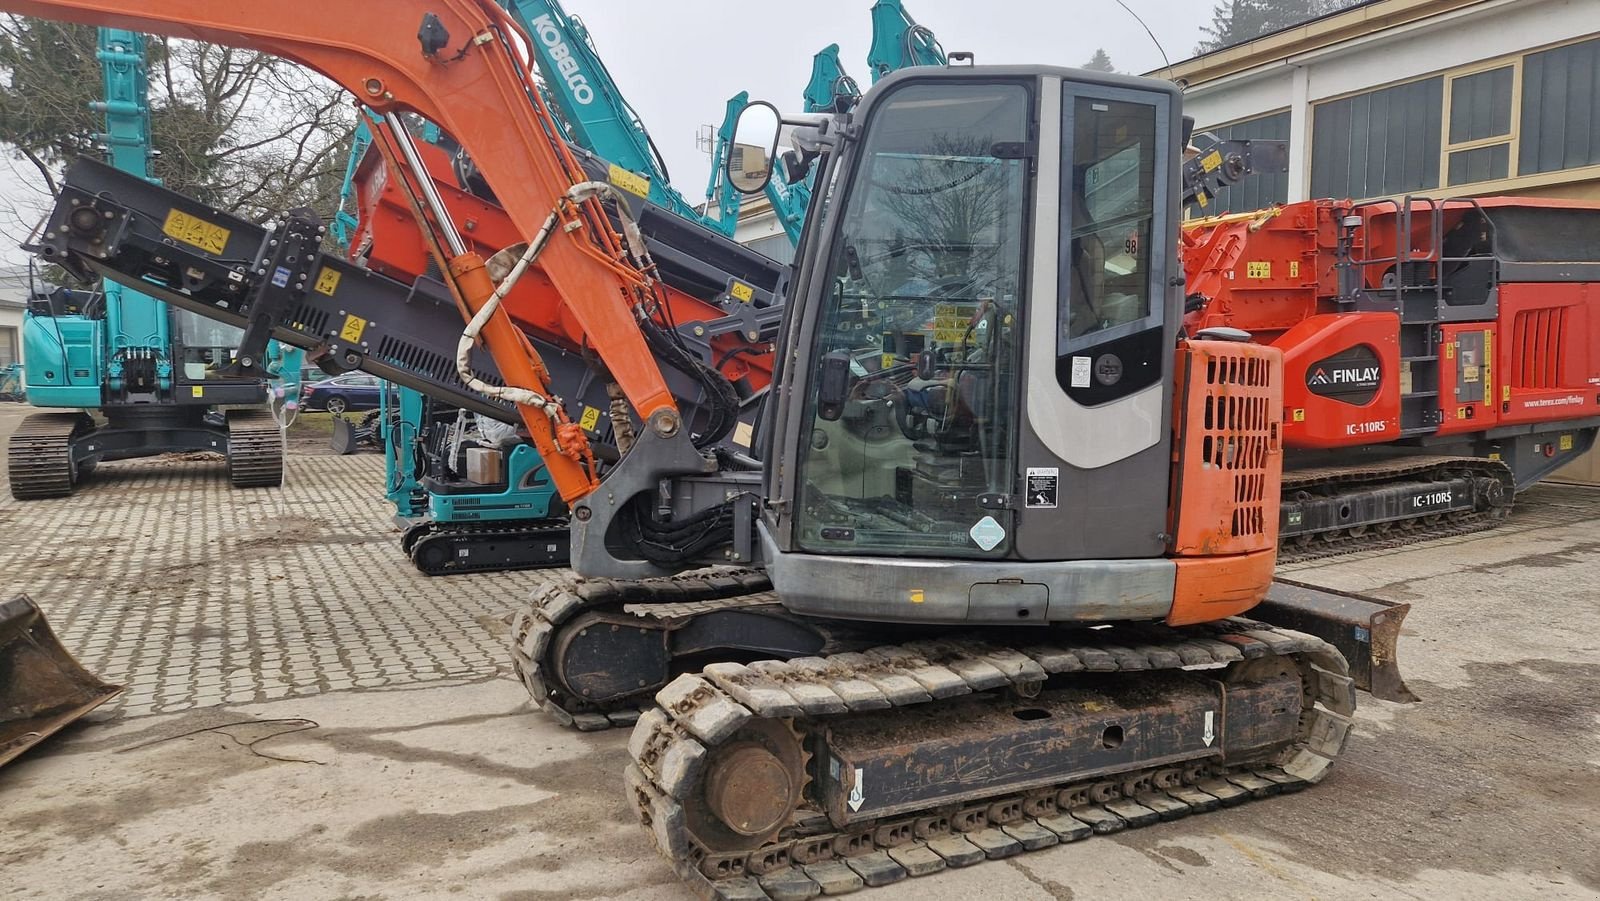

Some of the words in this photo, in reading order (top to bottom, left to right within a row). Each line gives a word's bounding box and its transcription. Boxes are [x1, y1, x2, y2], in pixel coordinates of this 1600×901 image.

[532, 13, 593, 104] KOBELCO
[1333, 367, 1379, 383] FINLAY
[1346, 421, 1385, 435] IC-110RS
[1413, 491, 1452, 507] IC-110RS
